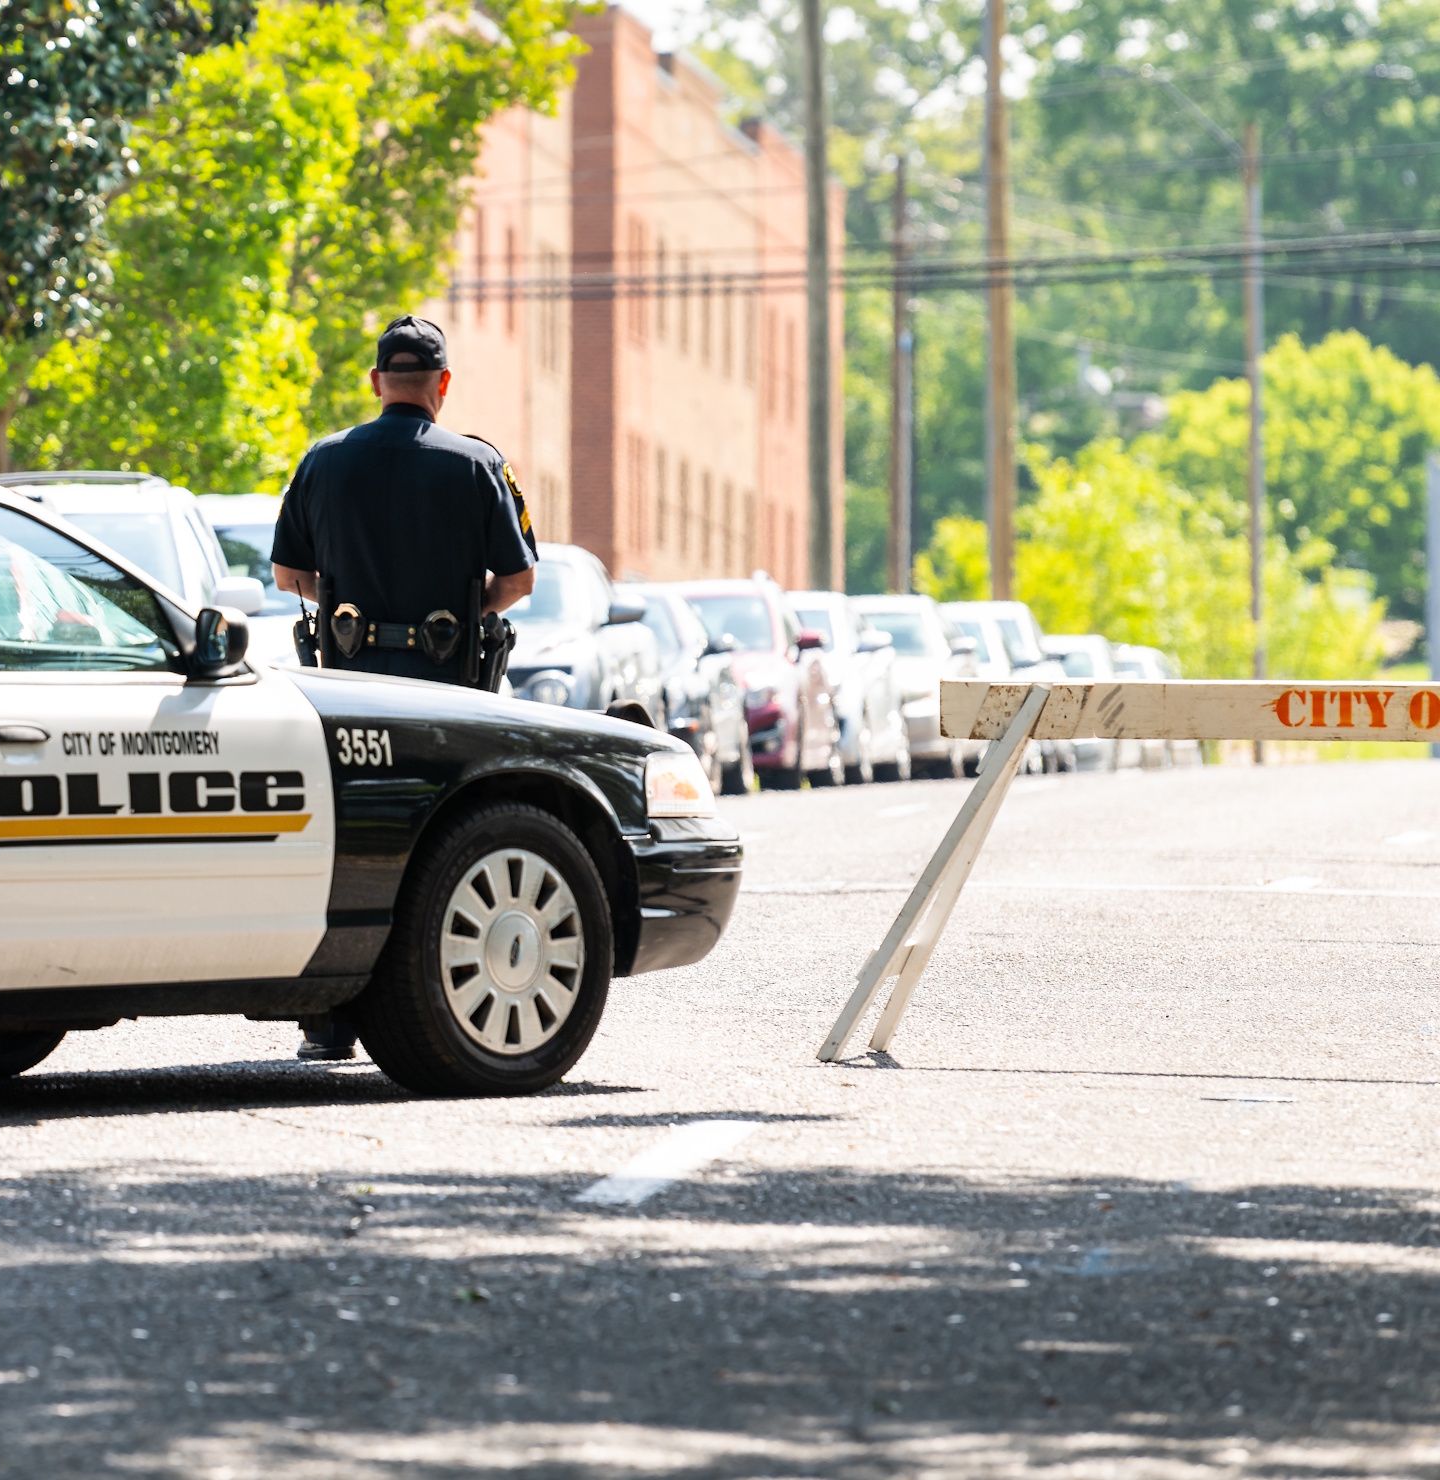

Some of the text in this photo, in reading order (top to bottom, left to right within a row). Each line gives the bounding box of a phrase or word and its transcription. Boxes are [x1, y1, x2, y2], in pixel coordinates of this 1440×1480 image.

[1276, 690, 1395, 728] CITY
[62, 730, 219, 756] CITY OF MONTGOMERY
[336, 727, 393, 767] 3551
